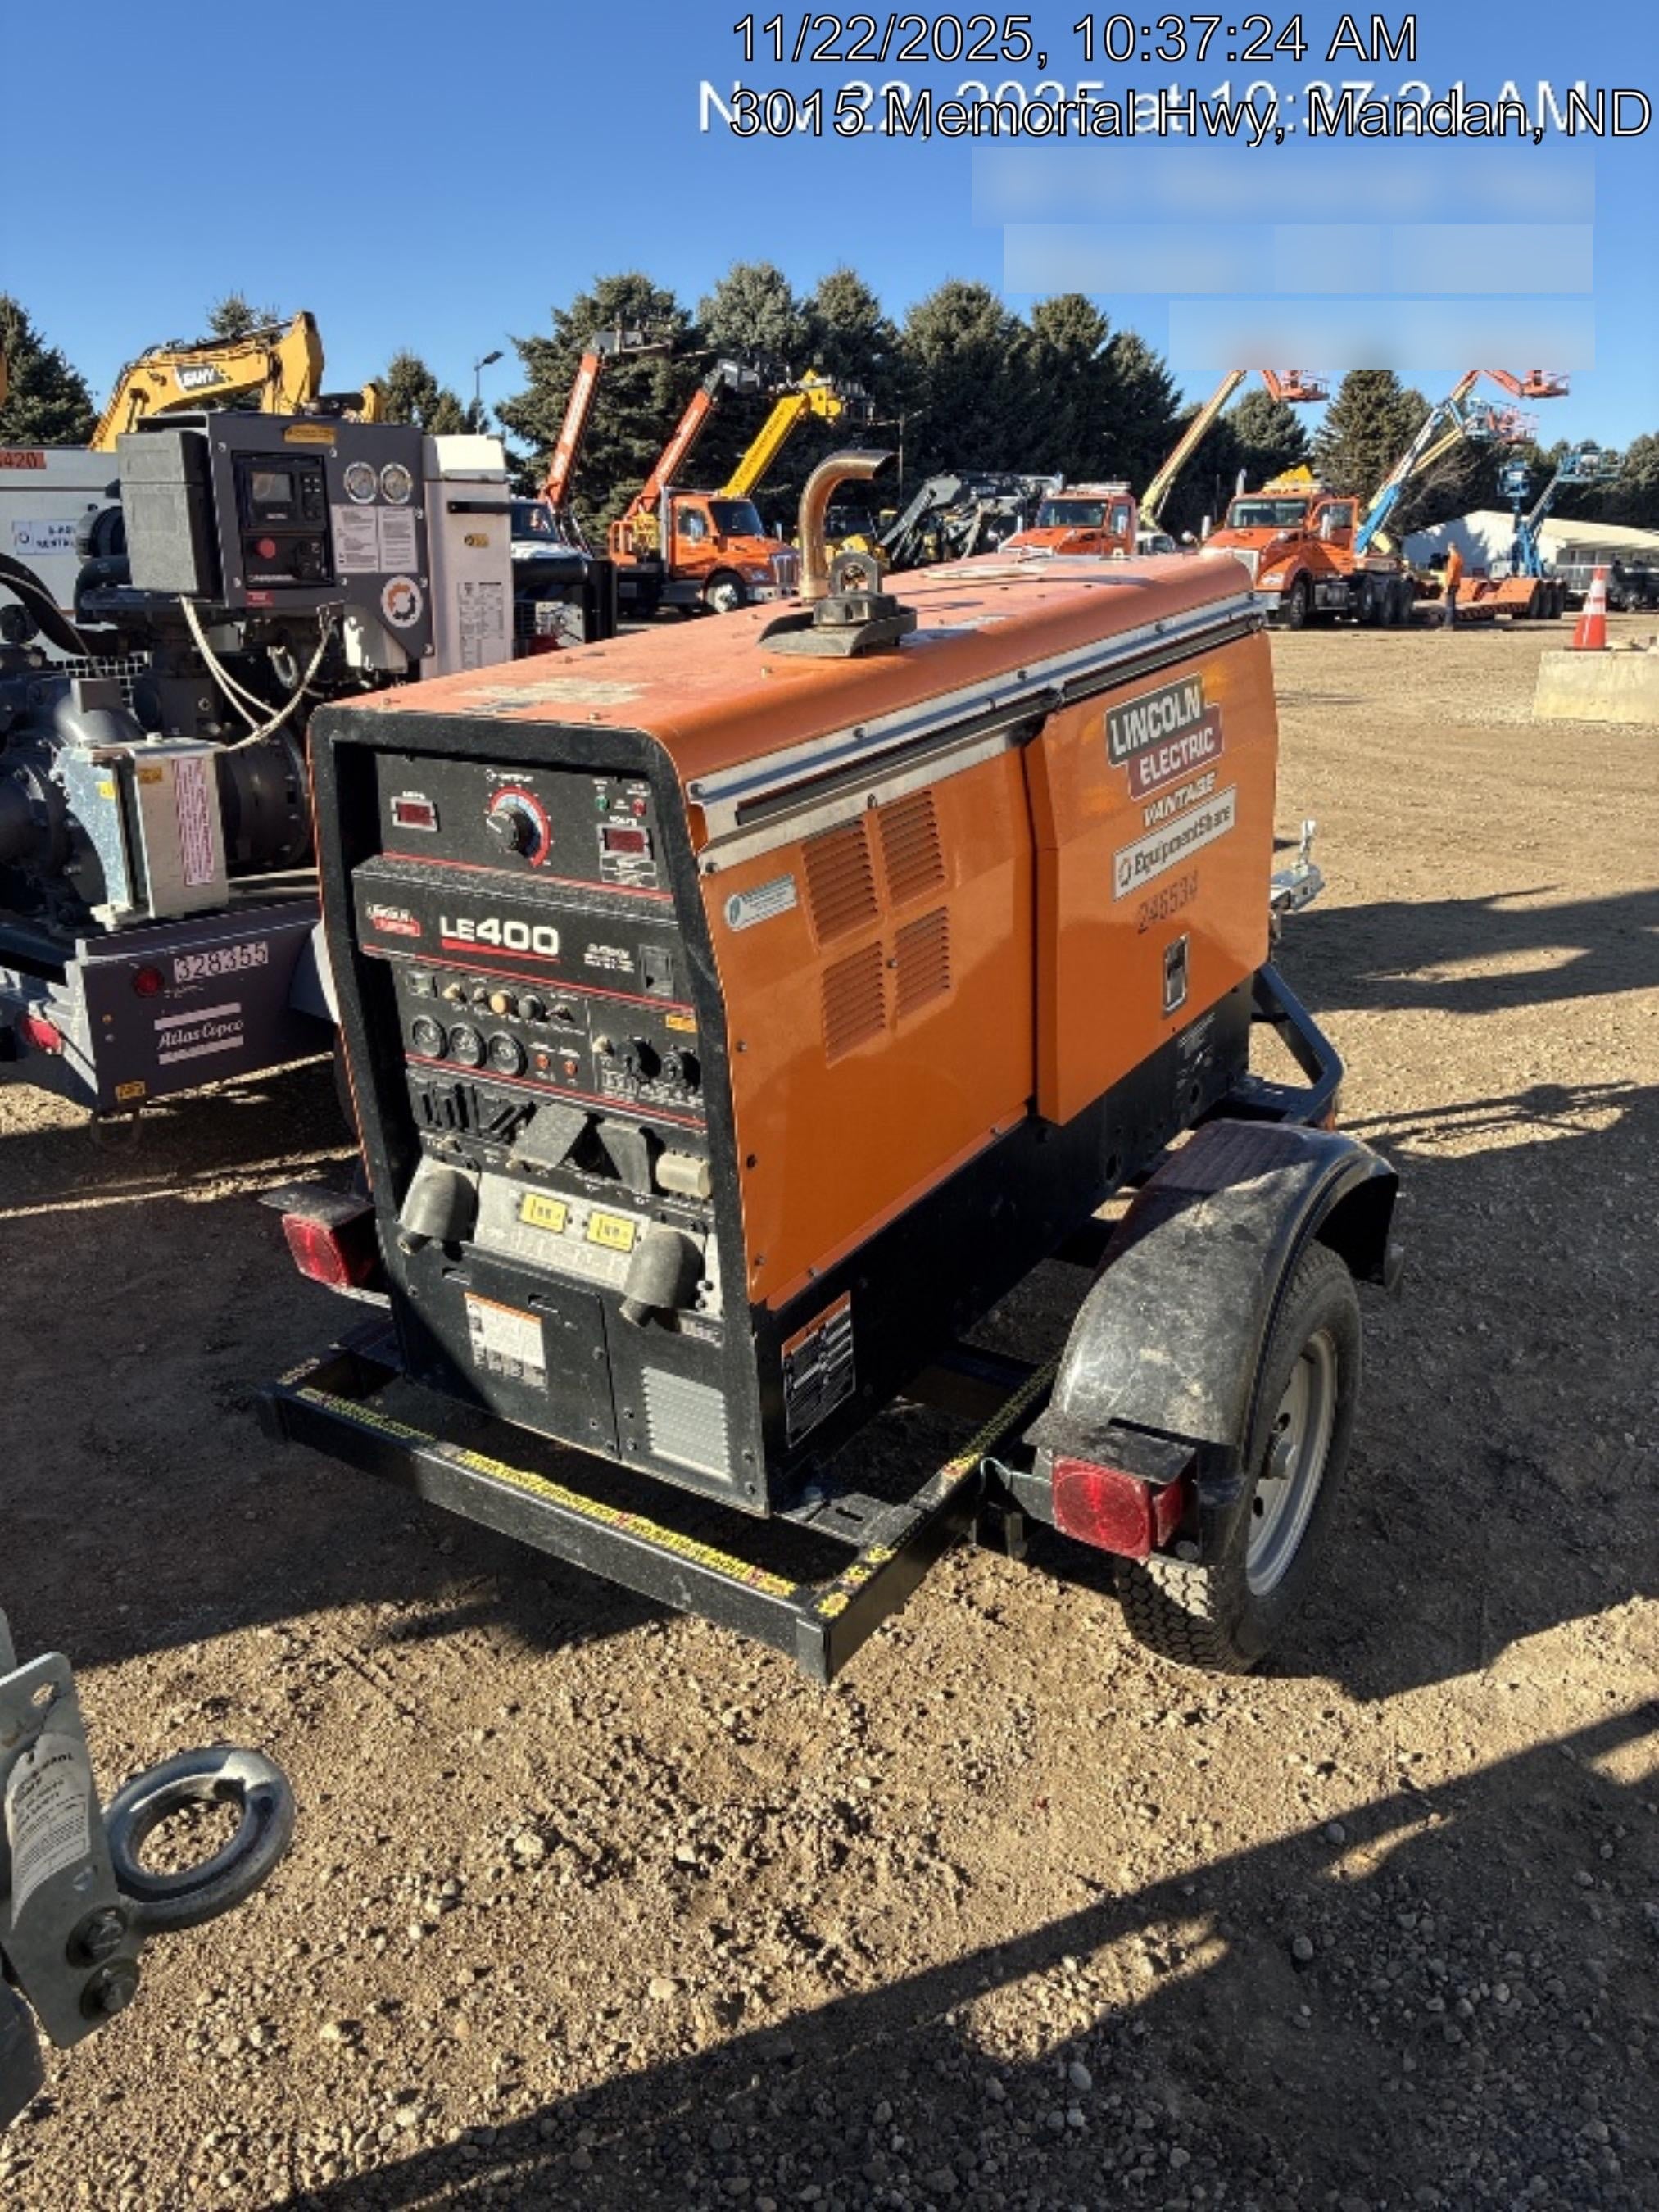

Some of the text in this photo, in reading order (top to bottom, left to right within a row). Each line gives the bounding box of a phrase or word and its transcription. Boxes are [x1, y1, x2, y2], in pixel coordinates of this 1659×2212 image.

[0, 451, 38, 468] 420
[1110, 684, 1202, 756] LINCOLN
[1140, 727, 1215, 785] ELECTRIC
[1134, 805, 1231, 875] EquipmentShare
[439, 915, 559, 956] LE400
[175, 941, 267, 981] 328355
[156, 1020, 244, 1050] Atlas Copco
